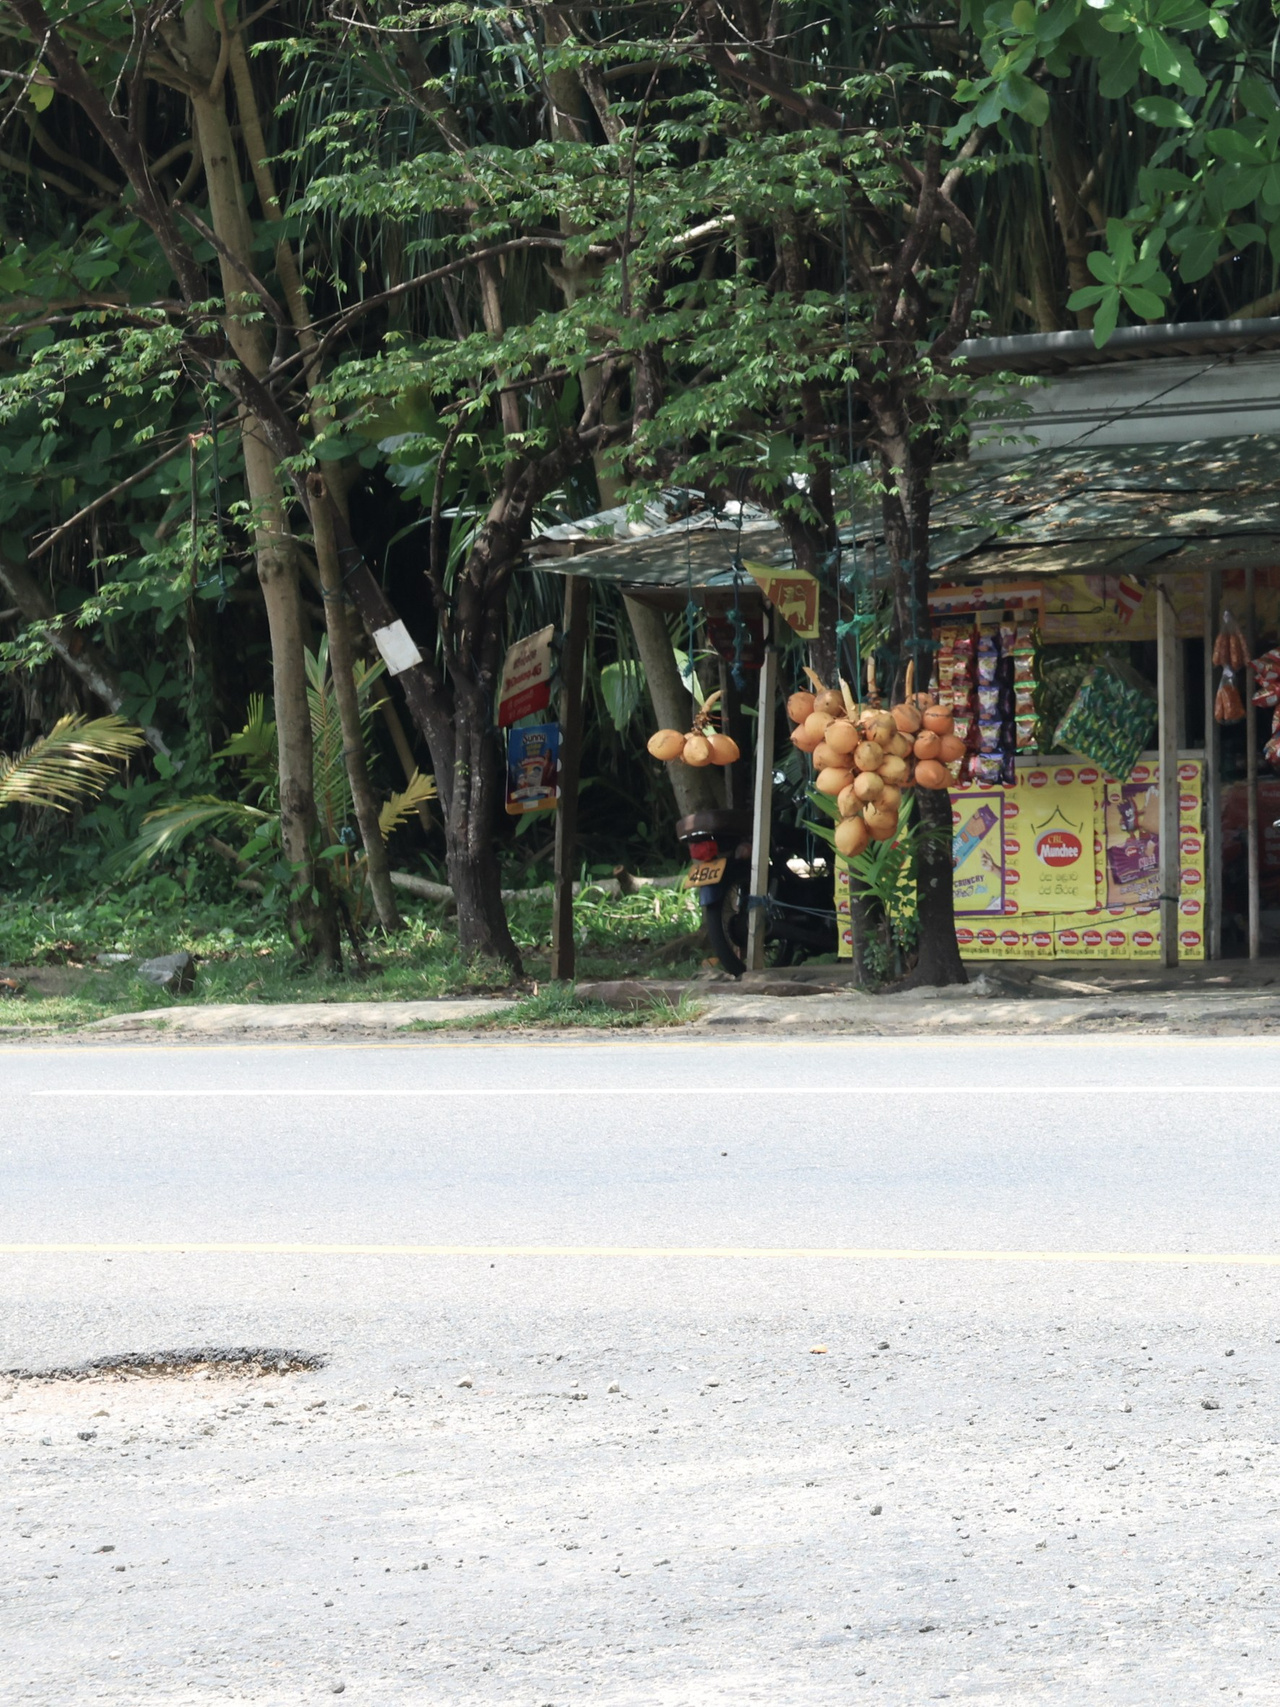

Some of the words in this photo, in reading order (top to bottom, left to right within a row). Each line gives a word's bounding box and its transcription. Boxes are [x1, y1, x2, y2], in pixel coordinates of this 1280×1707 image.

[523, 733, 546, 744] Sunny
[1047, 834, 1063, 844] CBL
[1039, 843, 1078, 858] Munchee
[953, 875, 984, 888] CRUNCHY
